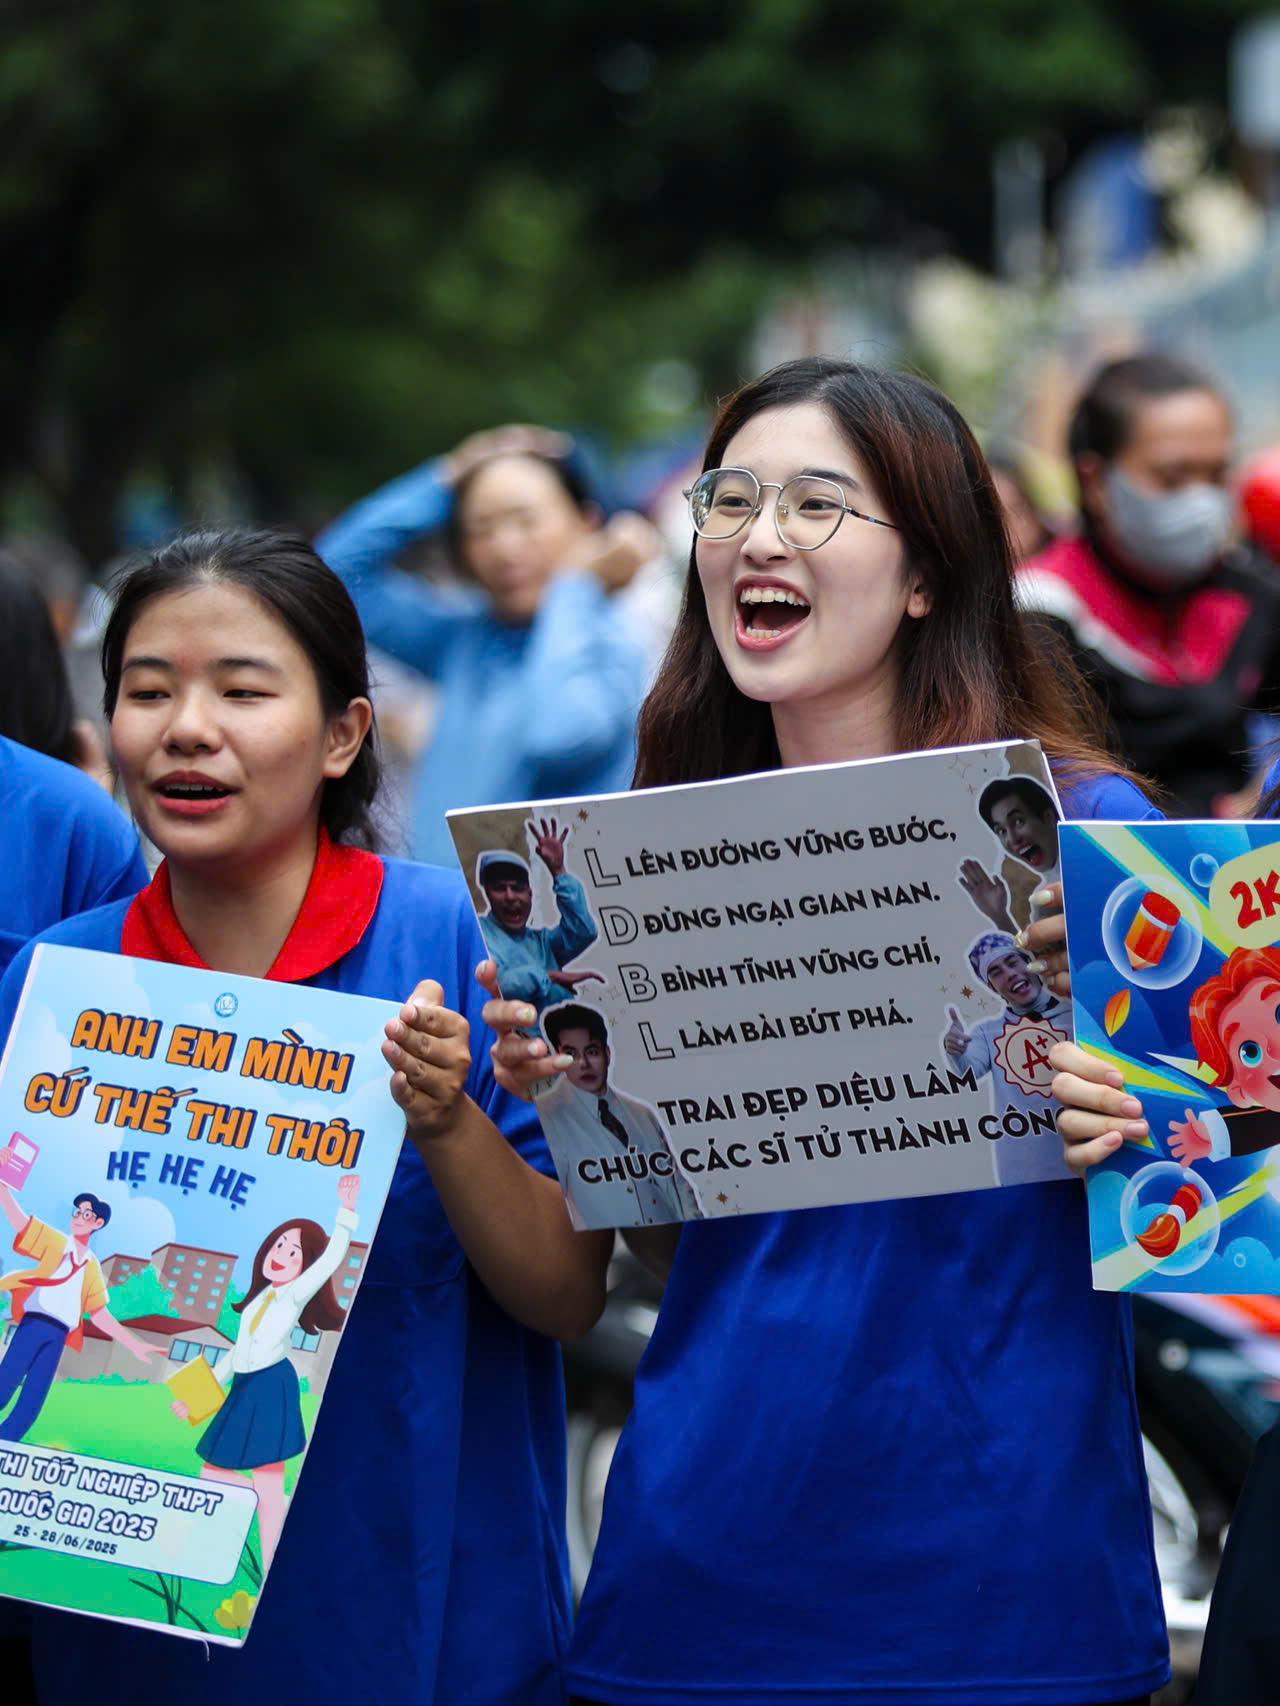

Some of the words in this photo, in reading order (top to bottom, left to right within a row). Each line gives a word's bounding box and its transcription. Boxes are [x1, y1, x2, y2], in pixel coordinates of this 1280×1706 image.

[584, 848, 622, 888] L
[624, 848, 678, 878] LÊN
[681, 838, 781, 871] ĐƯỜNG
[784, 828, 865, 858] VỮNG
[868, 815, 957, 849] BƯỚC,
[598, 905, 639, 946] D
[643, 906, 722, 935] ĐỪNG
[725, 897, 795, 927] NGẠI
[798, 888, 868, 917] GIAN
[870, 881, 941, 909] NAN.
[618, 962, 658, 1004] B
[661, 963, 728, 994] BÌNH
[729, 955, 797, 986] TĨNH
[798, 947, 879, 976] VỮNG
[883, 936, 941, 967] CHÍ,
[71, 1008, 163, 1059] ANH
[165, 1023, 237, 1072] EM
[240, 1028, 355, 1094] MÌNH
[638, 1021, 676, 1061] L
[678, 1020, 738, 1050] LÀM
[742, 1013, 788, 1041] BÀI
[850, 998, 914, 1031] PHÁ.
[24, 1066, 92, 1119] CỨ
[93, 1081, 198, 1135] THẾ
[186, 1097, 258, 1149] THI
[265, 1113, 365, 1169] THÔI
[657, 1094, 737, 1127] TRAI
[742, 1088, 809, 1122] ĐẸP
[814, 1071, 897, 1112] DIỆU
[902, 1063, 979, 1100] LÂM
[577, 1146, 675, 1186] CHÚC
[679, 1137, 752, 1173] CÁC
[757, 1129, 790, 1166] SĨ
[794, 1124, 842, 1160] TỬ
[847, 1114, 972, 1156] THÀNH
[977, 1104, 1065, 1141] CÔN
[106, 1150, 151, 1188] HẸ
[159, 1153, 205, 1195] HẸ
[209, 1163, 256, 1211] HẸ
[32, 1455, 79, 1487] TỐT
[77, 1466, 160, 1504] NGHIỆP
[162, 1482, 223, 1516] THPT
[0, 1487, 54, 1520] QUỐC
[56, 1499, 95, 1531] GIA
[95, 1508, 157, 1541] 2025
[13, 1525, 31, 1538] 25
[40, 1528, 118, 1556] 28/06/2025
